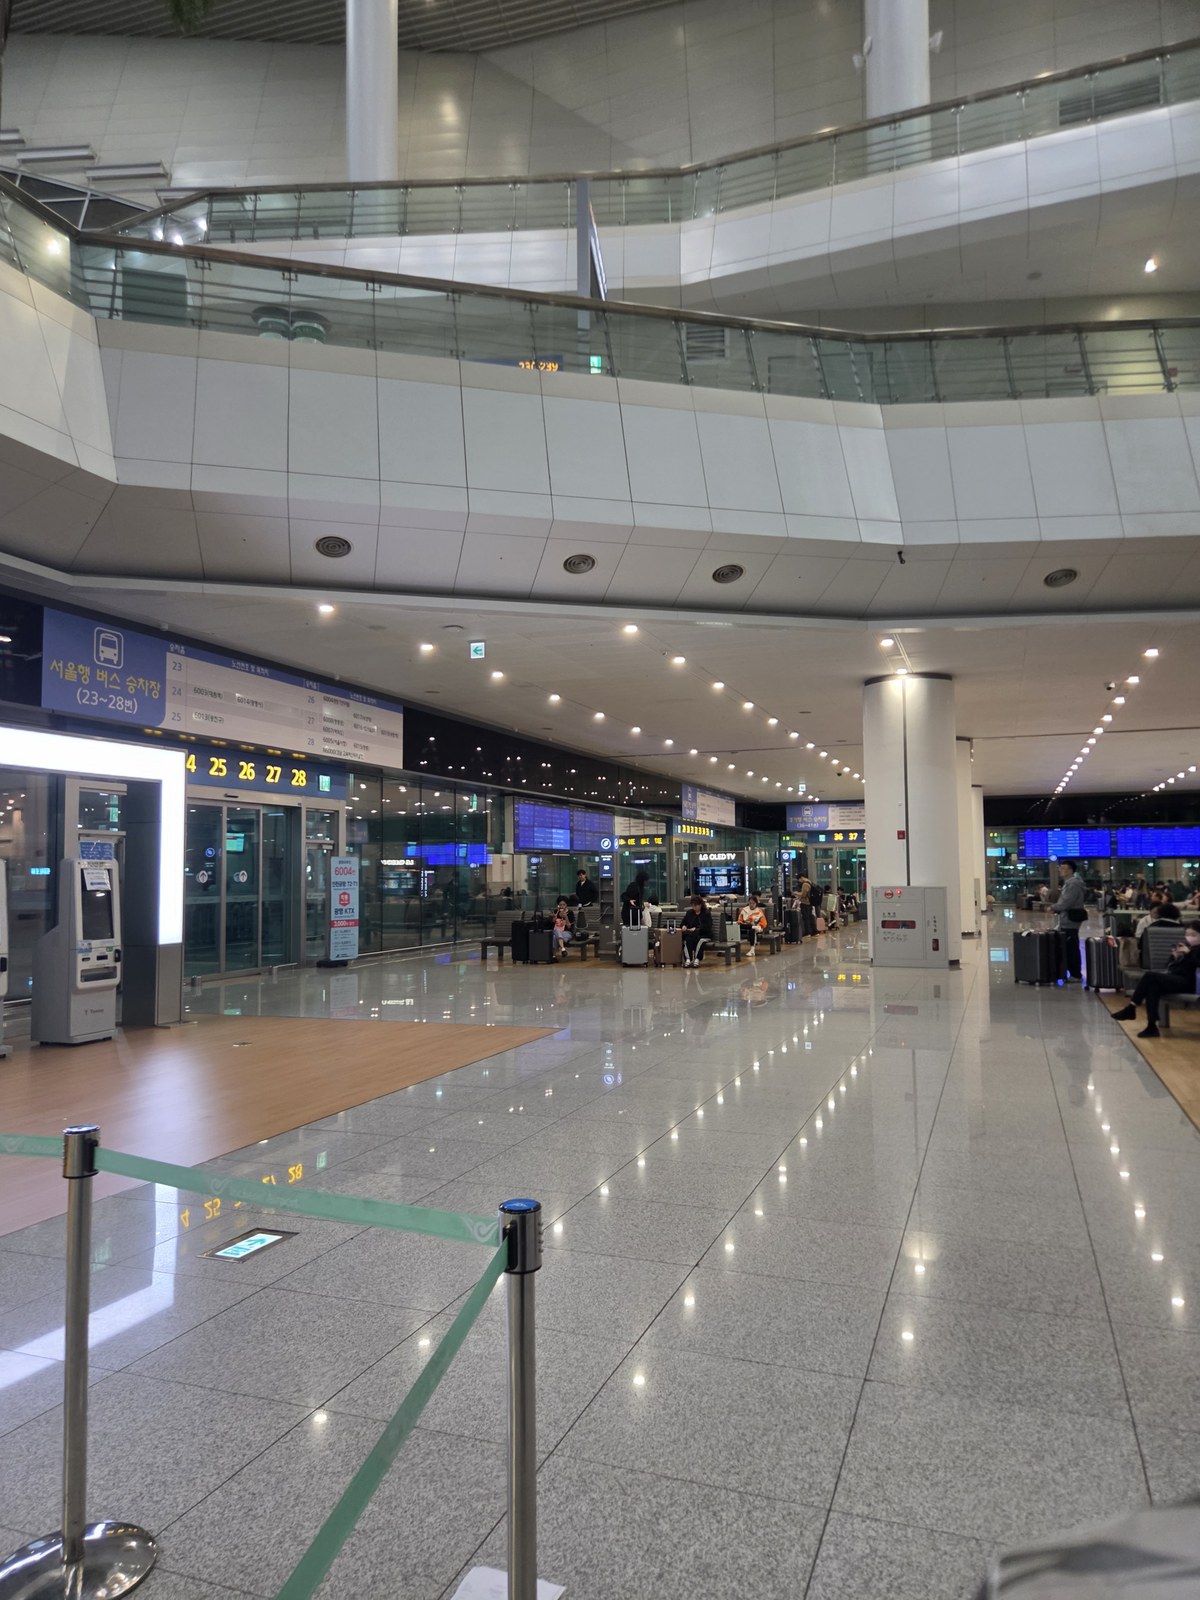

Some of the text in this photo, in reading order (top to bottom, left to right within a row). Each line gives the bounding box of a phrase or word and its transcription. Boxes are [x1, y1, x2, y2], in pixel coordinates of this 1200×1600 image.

[171, 661, 183, 672] 23
[49, 659, 160, 699] 서울행 버스 승차장
[171, 686, 182, 697] 24
[76, 687, 138, 715] (23~28번)
[171, 711, 182, 722] 25
[209, 757, 228, 777] 25
[238, 761, 256, 781] 26
[265, 765, 282, 783] 27
[291, 768, 307, 787] 28
[833, 832, 859, 841] 36 37
[699, 853, 737, 861] LG OLED TV
